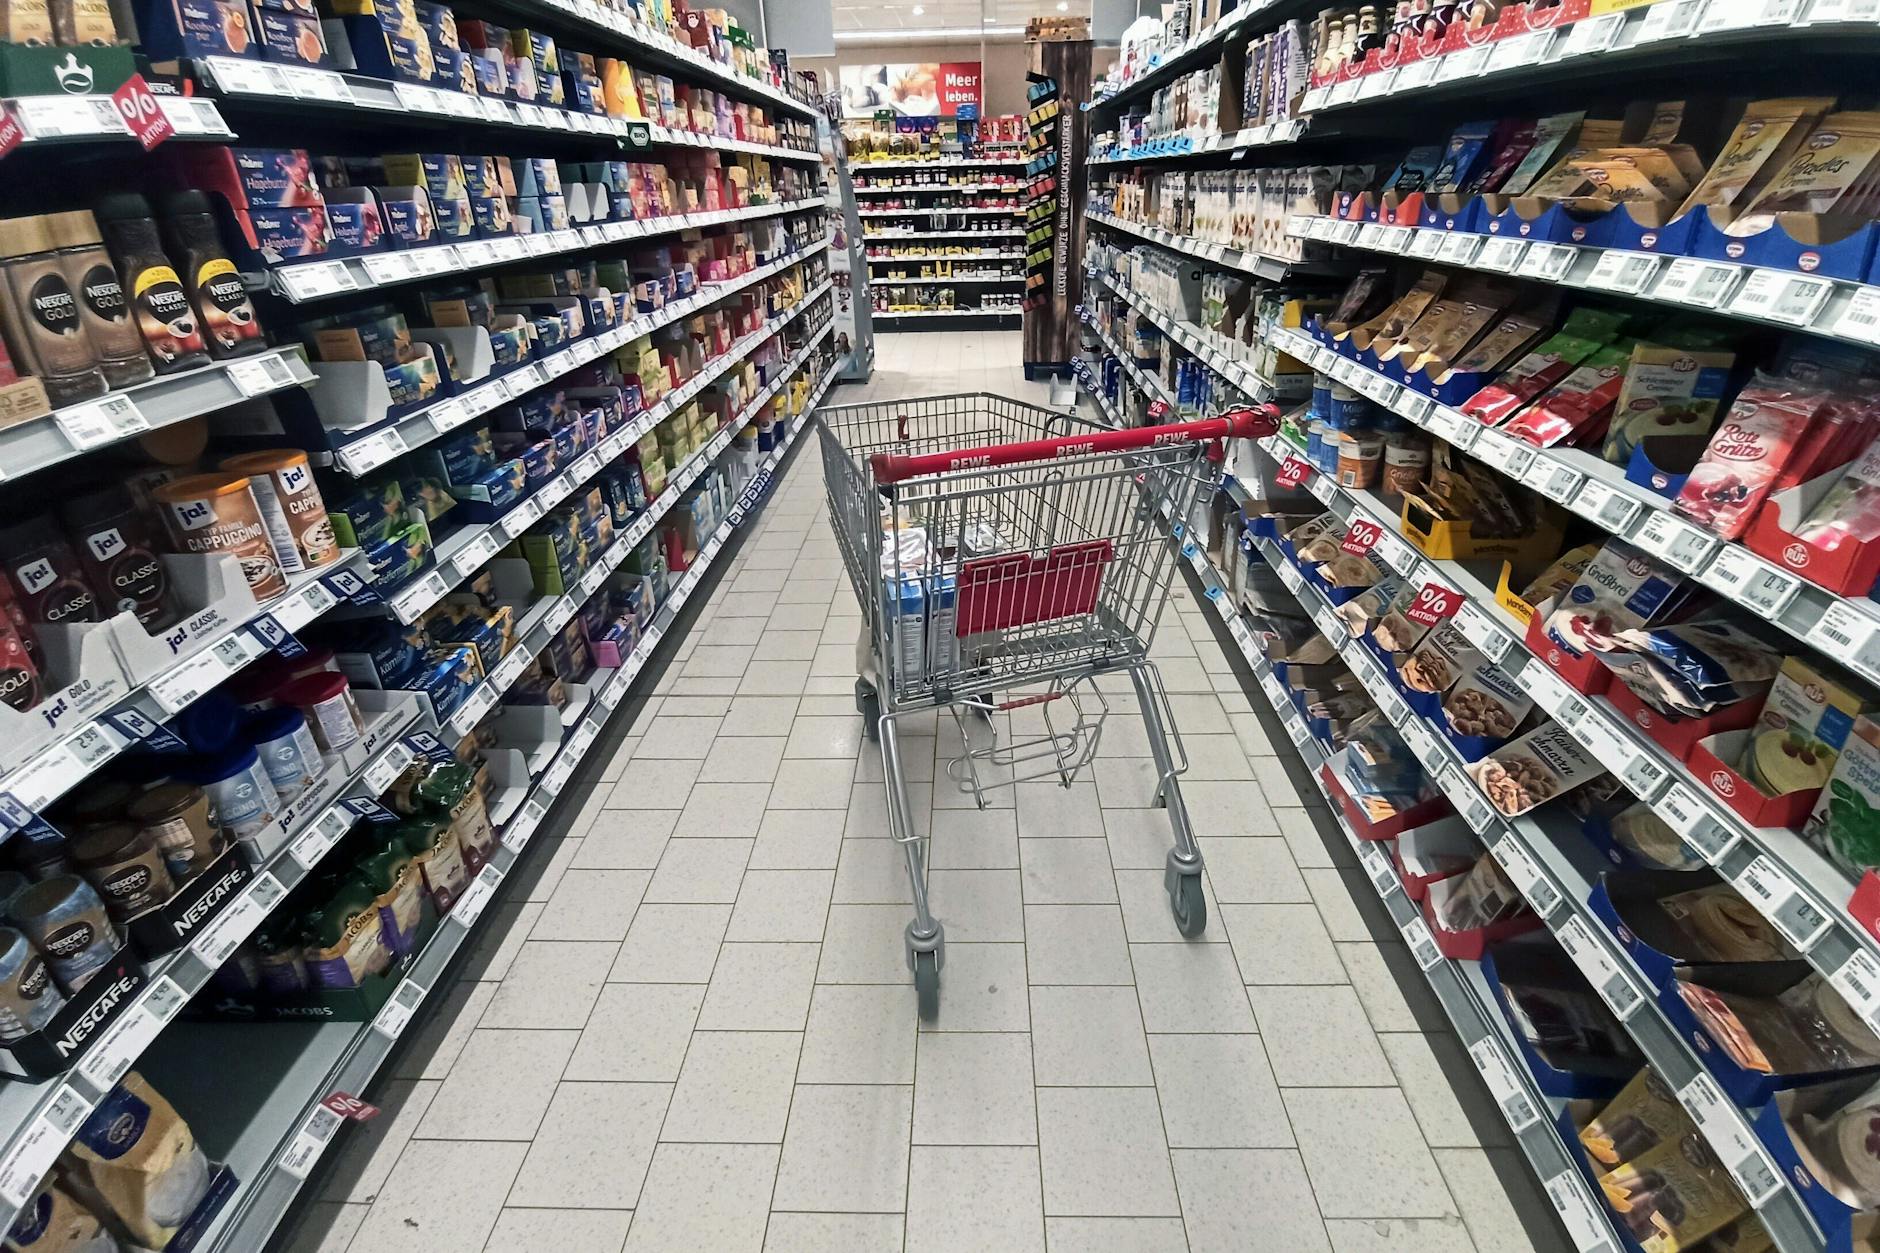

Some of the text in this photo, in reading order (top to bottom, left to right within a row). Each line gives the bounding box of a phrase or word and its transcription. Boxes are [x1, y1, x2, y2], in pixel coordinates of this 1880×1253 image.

[945, 74, 978, 87] Meer
[945, 91, 978, 102] leben.
[141, 118, 168, 146] AKTION
[96, 294, 123, 308] GOLD
[218, 291, 245, 302] CLASSIC
[46, 306, 76, 321] GOLD
[157, 302, 187, 313] CLASSIC
[1154, 431, 1190, 446] REWE
[1724, 423, 1760, 444] Rote
[1056, 442, 1094, 457] REWE
[1713, 440, 1764, 458] Grütze
[951, 454, 990, 470] REWE
[282, 467, 305, 490] ja!
[1275, 476, 1297, 488] AKTION
[178, 502, 208, 528] ja!
[95, 532, 117, 556] ja!
[187, 523, 263, 552] CAPPUCCINO
[1352, 524, 1374, 546] %
[1342, 541, 1367, 555] AKTION
[1786, 548, 1807, 564] RUF
[24, 563, 49, 588] ja!
[115, 561, 159, 588] CLASSIC
[1627, 557, 1649, 576] RUF
[1587, 564, 1633, 597] Grießbrei
[47, 591, 92, 622] CLASSIC
[1420, 588, 1447, 614] %
[190, 609, 218, 632] CLASSIC
[1408, 608, 1438, 624] AKTION
[165, 627, 188, 656] ja!
[68, 679, 92, 699] GOLD
[42, 698, 69, 729] ja!
[362, 734, 377, 754] ja!
[1713, 774, 1735, 794] RUF
[277, 808, 296, 834] ja!
[113, 876, 147, 896] GOLD
[345, 911, 375, 944] JACOBS
[56, 934, 90, 956] GOLD
[276, 1005, 334, 1018] JACOBS
